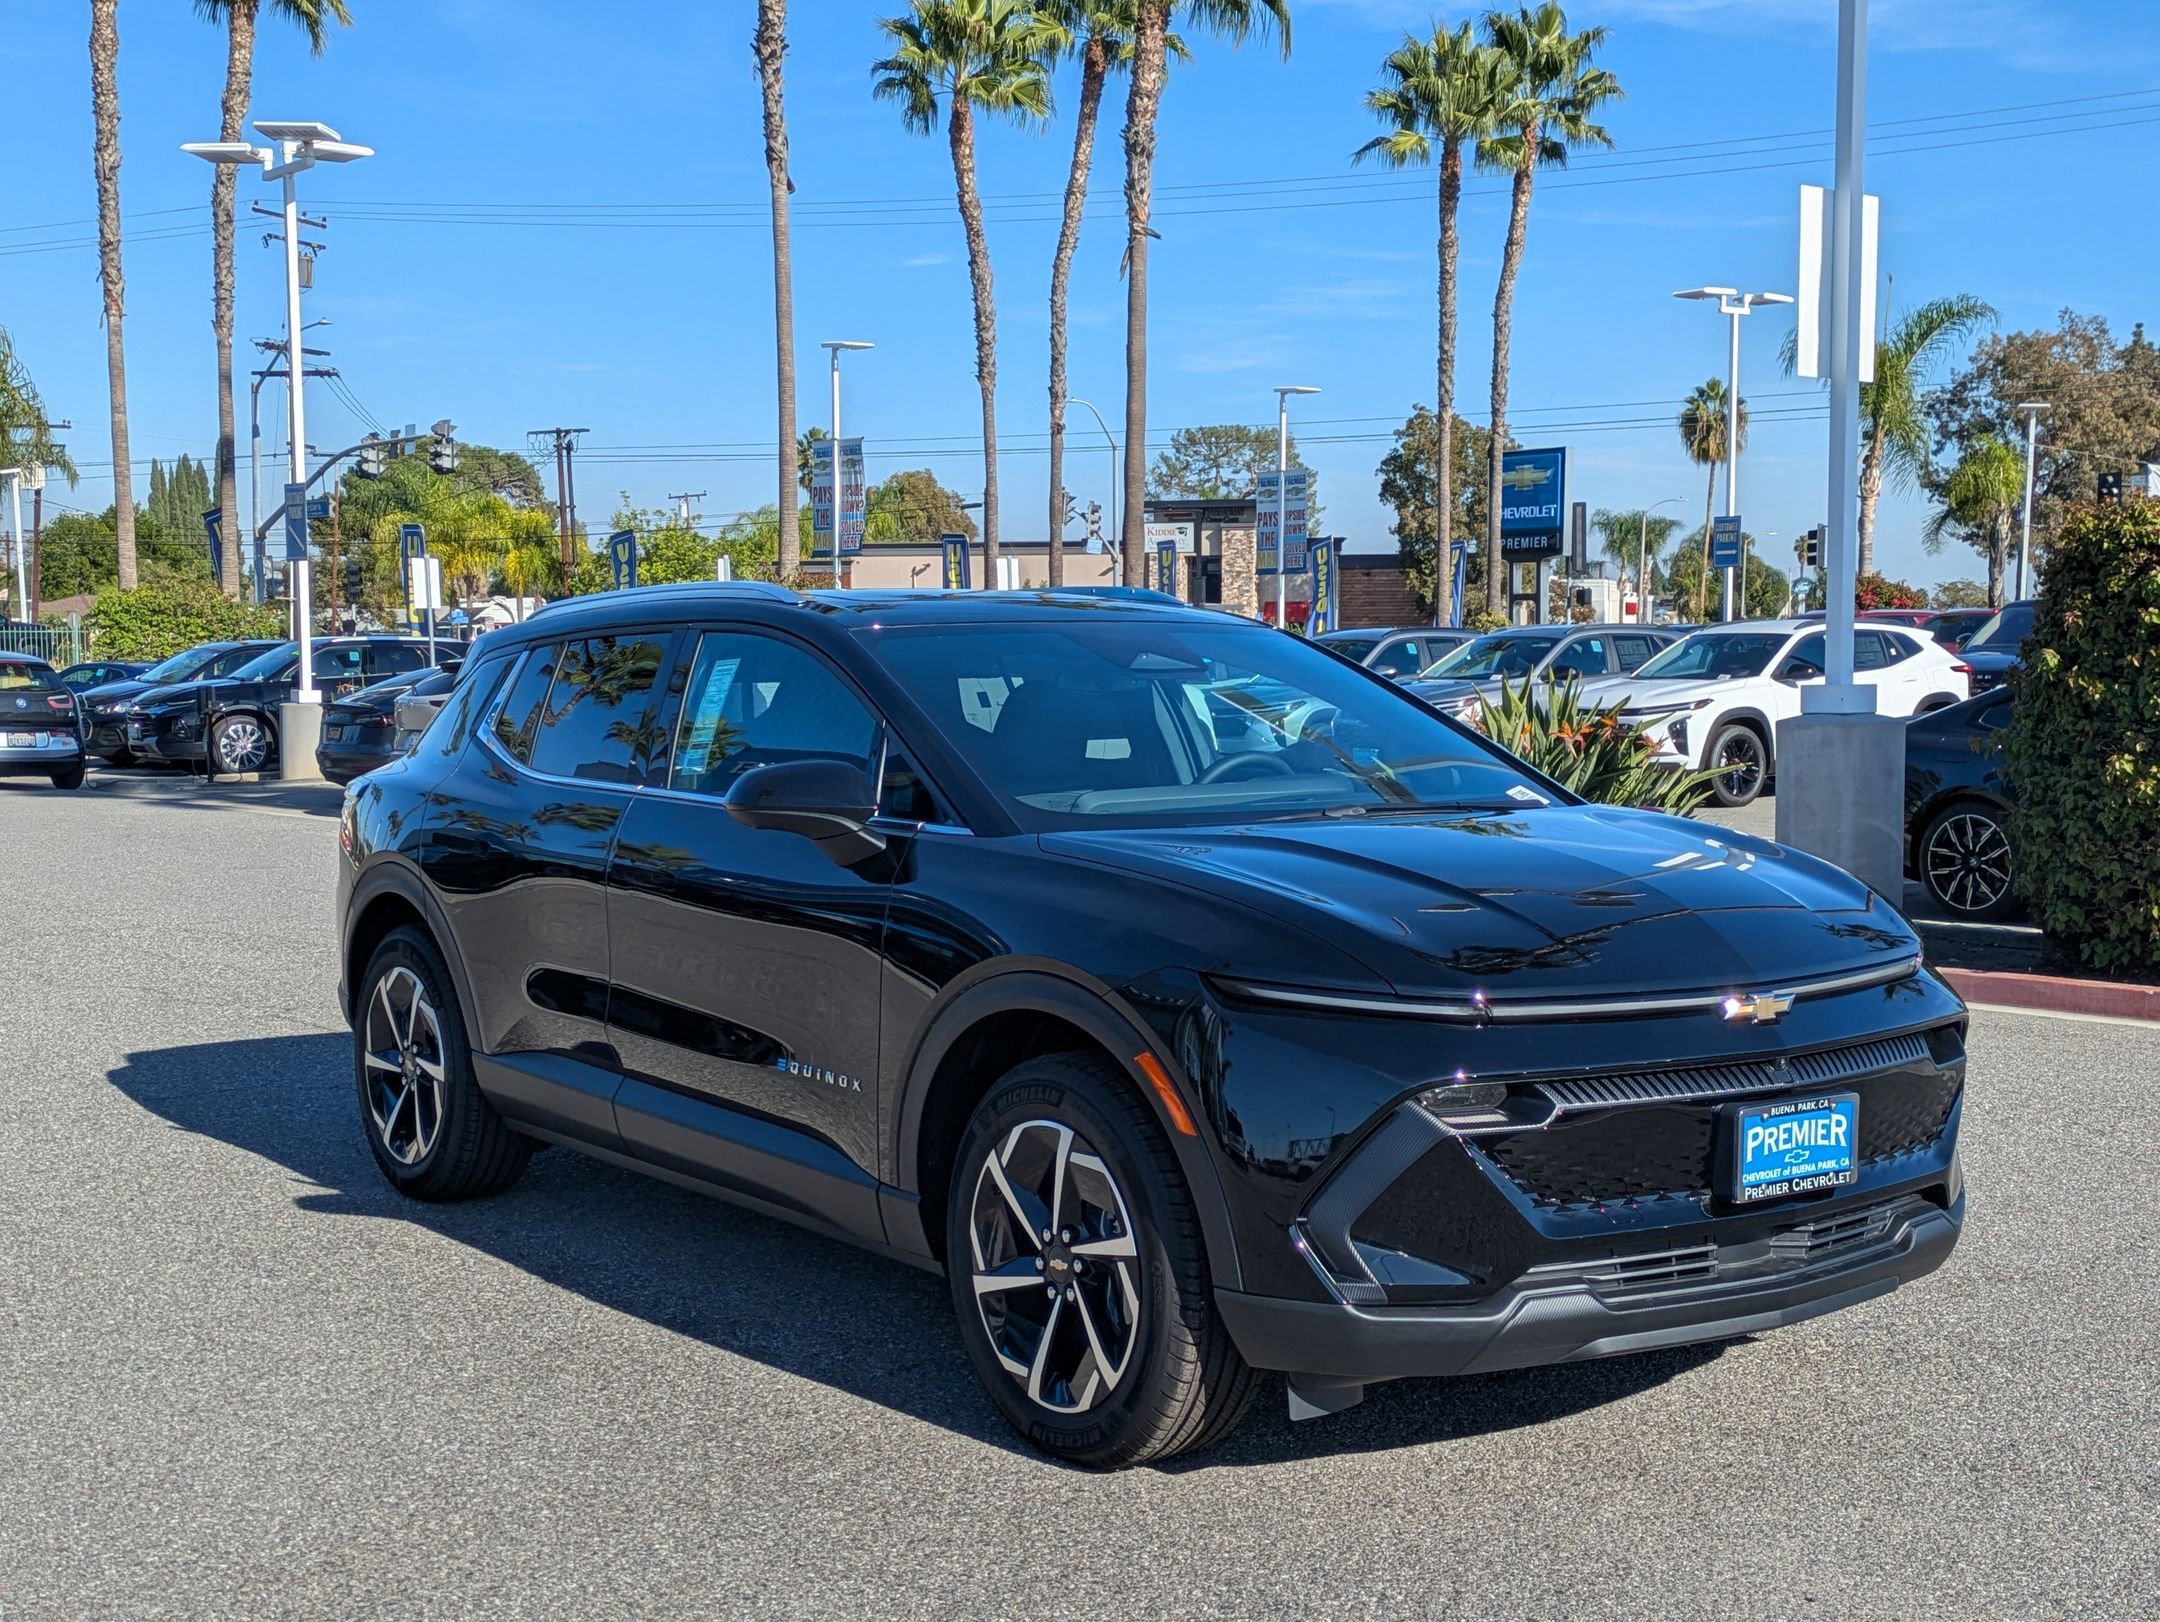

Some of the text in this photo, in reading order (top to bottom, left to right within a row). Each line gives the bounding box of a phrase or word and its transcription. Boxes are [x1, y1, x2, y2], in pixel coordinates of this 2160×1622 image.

[813, 486, 832, 504] PAYS
[815, 509, 830, 526] THE
[1257, 511, 1279, 528] PAYS
[1501, 504, 1557, 519] HEVROLET
[841, 520, 863, 534] SOLVED
[1146, 527, 1176, 537] KIDDIE
[1261, 531, 1276, 548] THE
[1501, 536, 1548, 550] PREMIER
[1716, 532, 1737, 543] PARKING
[1315, 547, 1328, 614] USED
[777, 1058, 861, 1092] EQUINOX
[996, 1085, 1061, 1113] MICHELIN
[1771, 1099, 1829, 1116] BUENA PARK, CA
[1746, 1113, 1848, 1163] PREMIER
[1743, 1168, 1781, 1183] CHEVROLET
[1782, 1166, 1792, 1176] of
[1792, 1162, 1817, 1175] BUENA
[1840, 1157, 1850, 1167] CA
[1744, 1171, 1851, 1200] PREMIER CHEVROLET
[1031, 1424, 1101, 1447] MICHELIN
